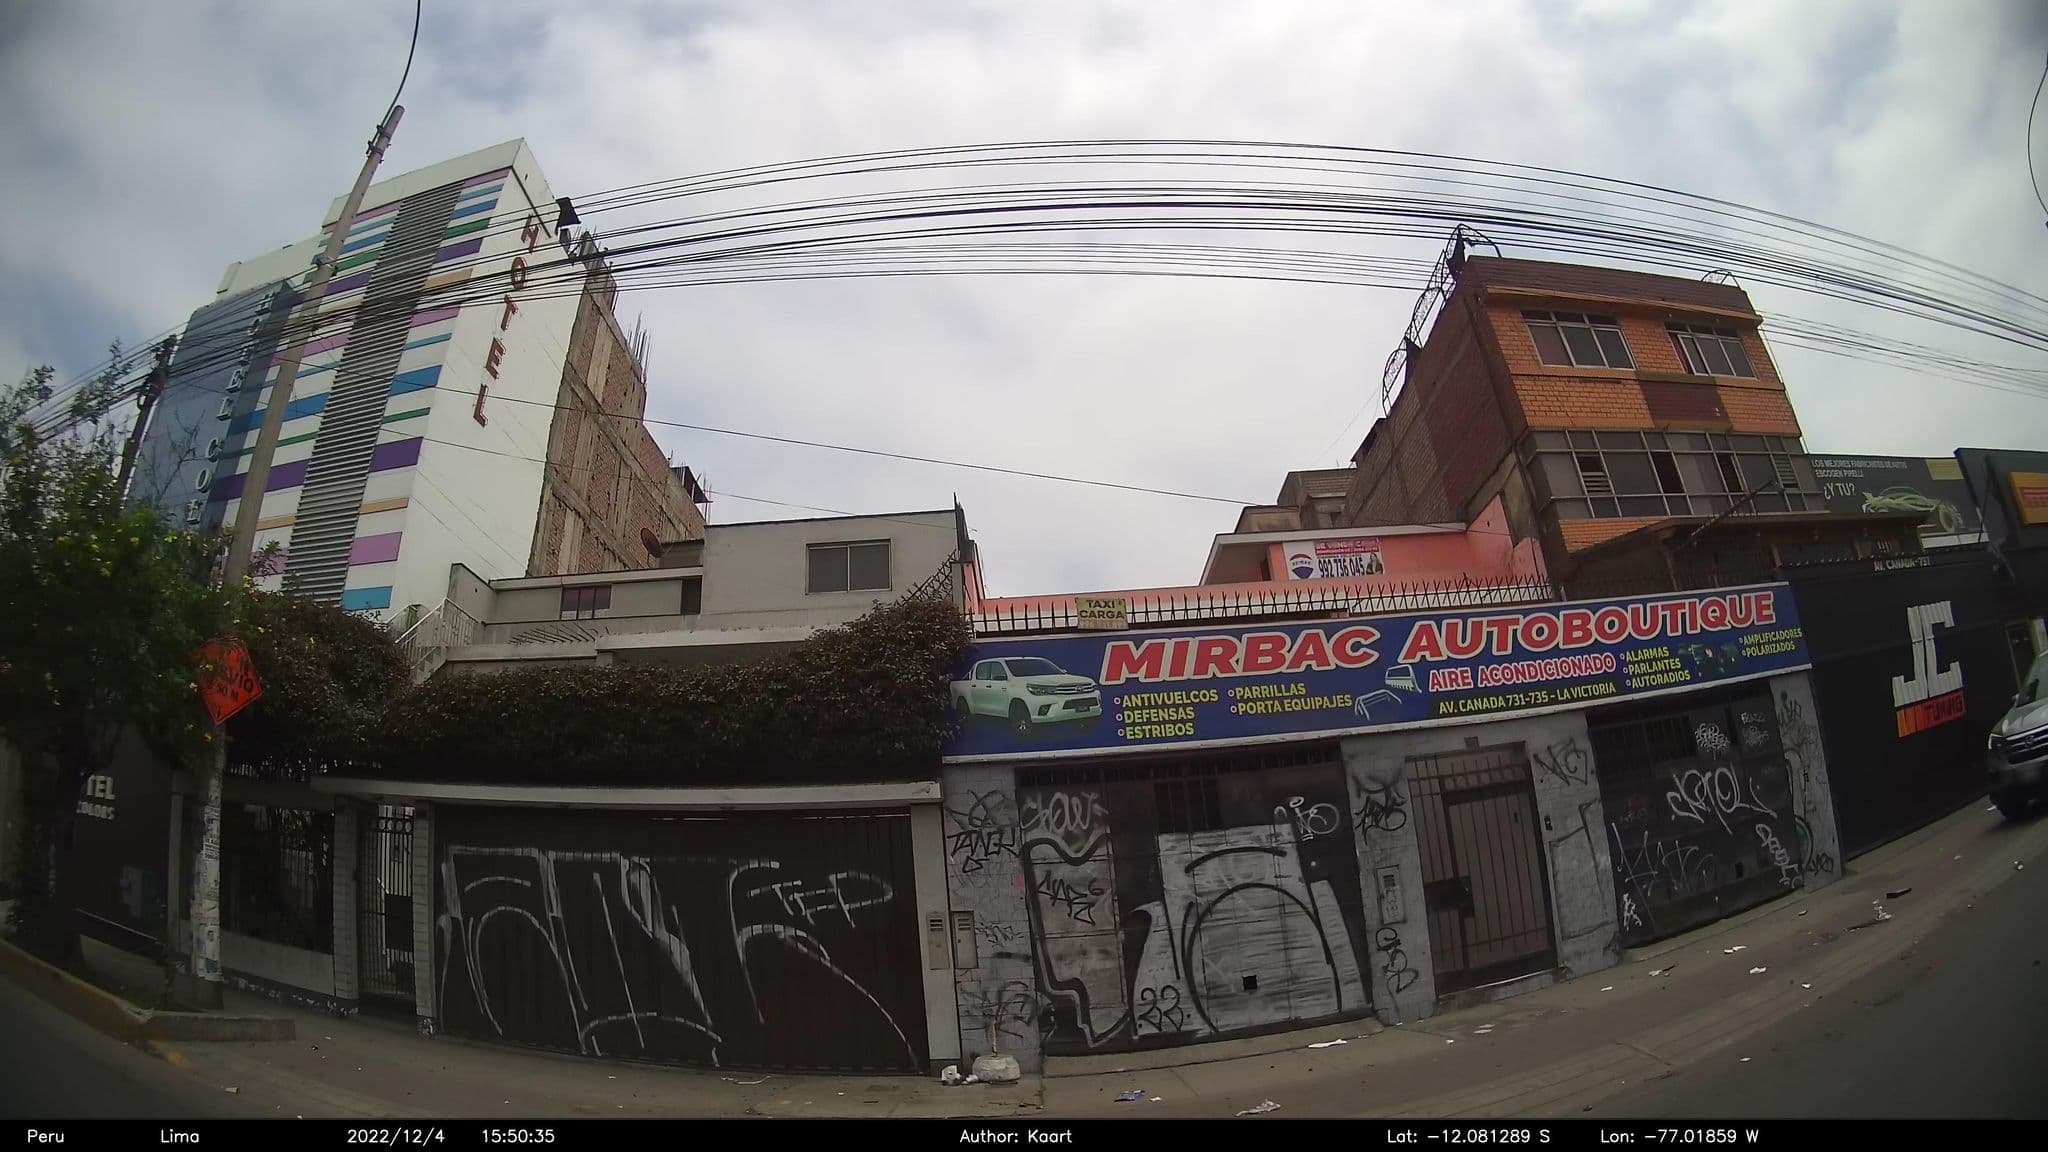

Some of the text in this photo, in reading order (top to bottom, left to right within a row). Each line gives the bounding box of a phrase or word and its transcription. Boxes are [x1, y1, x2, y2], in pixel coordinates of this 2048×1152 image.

[473, 213, 541, 428] HOTEL
[1318, 556, 1365, 578] 992 736 045
[1086, 599, 1115, 609] TAXI
[1079, 610, 1125, 619] CARGA
[1102, 592, 1775, 684] MIRBAC AUTOBOUTIQUE
[1744, 628, 1802, 645] AMPLIFICADORES
[1626, 646, 1669, 662] ALARMAS
[1746, 641, 1796, 657] POLARIZADOS
[1430, 653, 1616, 692] AIRE ACONDICIONADO
[1628, 658, 1681, 675] PARLANTES
[1632, 670, 1691, 689] AUTORADIOS
[1122, 689, 1219, 708] ANTIVUELCOS
[1235, 683, 1306, 699] PARRILLAS
[1439, 701, 1457, 714] AV.
[1459, 697, 1505, 712] CANADA
[1506, 690, 1548, 707] 731-735
[1556, 688, 1571, 701] LA
[1571, 682, 1616, 699] VICTORIA
[1238, 694, 1352, 715] PORTA EQUIPAJES
[1124, 706, 1195, 723] DEFENSAS
[1125, 722, 1194, 740] ESTRIBOS
